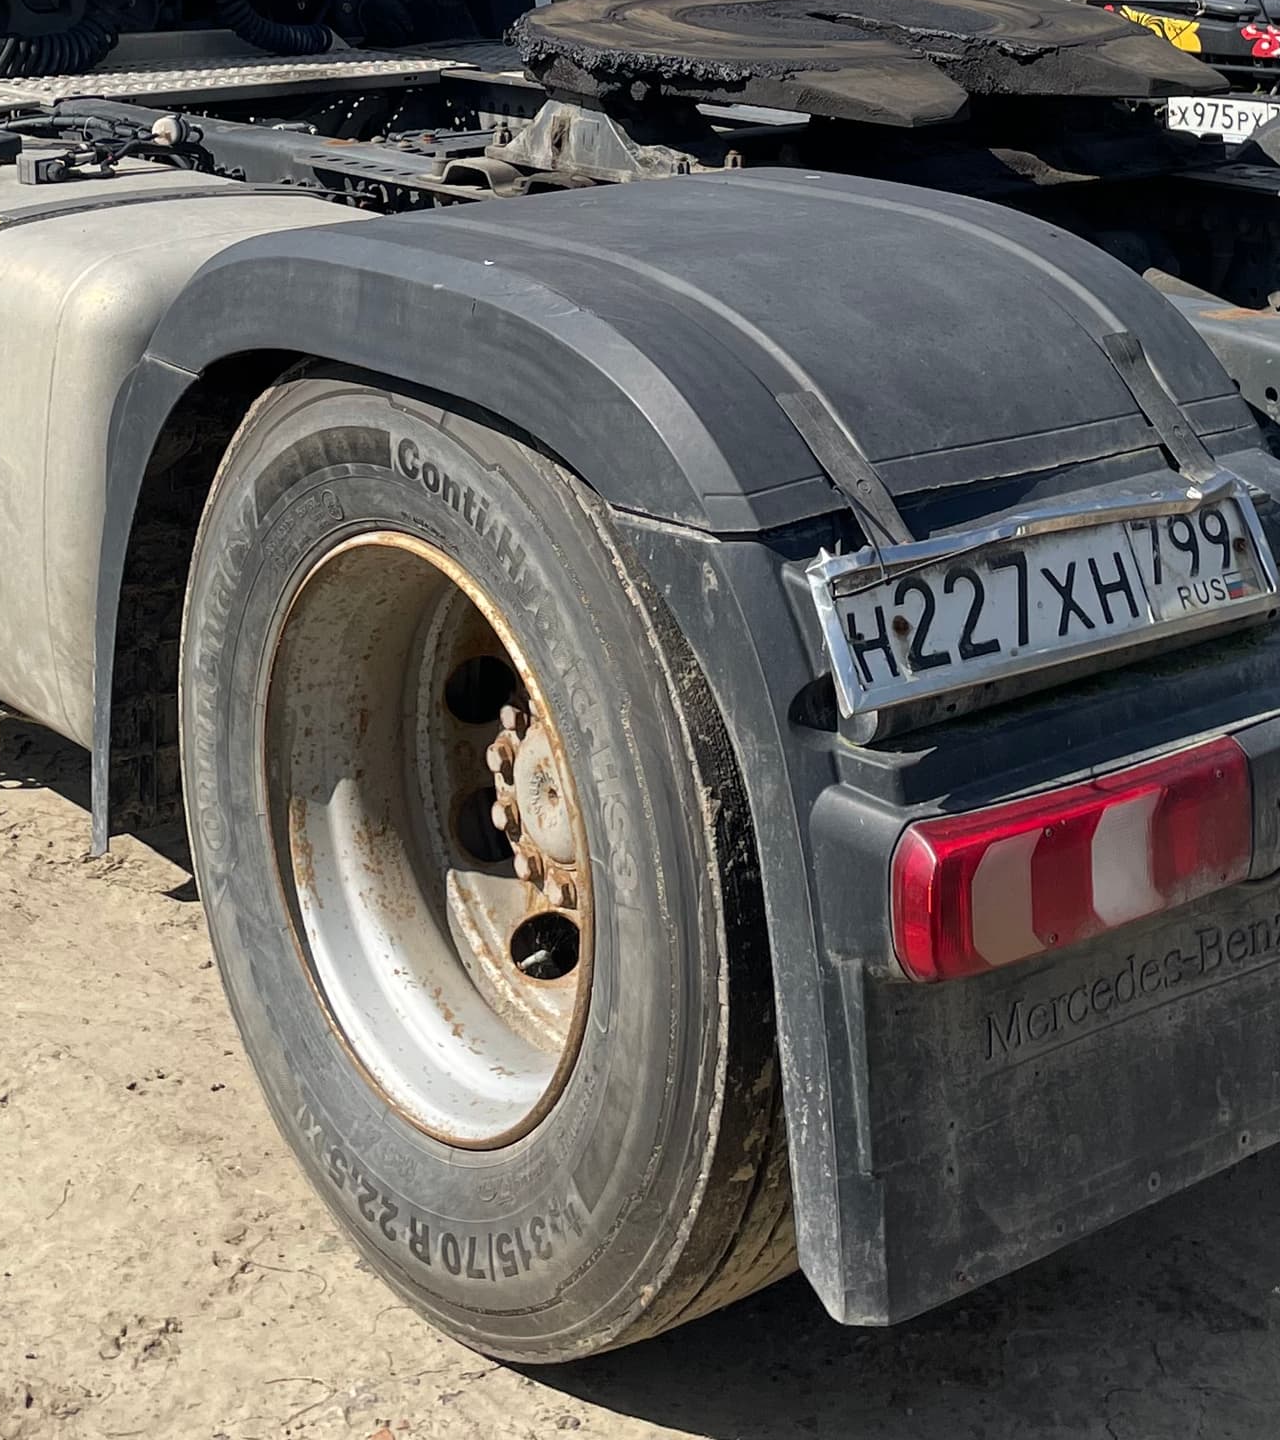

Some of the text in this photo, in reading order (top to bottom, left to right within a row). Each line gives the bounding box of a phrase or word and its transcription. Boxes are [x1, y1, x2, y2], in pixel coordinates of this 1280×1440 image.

[1130, 509, 1230, 585] 799
[1177, 578, 1226, 610] RUS
[395, 436, 488, 537] Conti
[589, 742, 639, 897] HS3
[407, 1215, 430, 1264] R
[438, 1212, 556, 1283] 315/70
